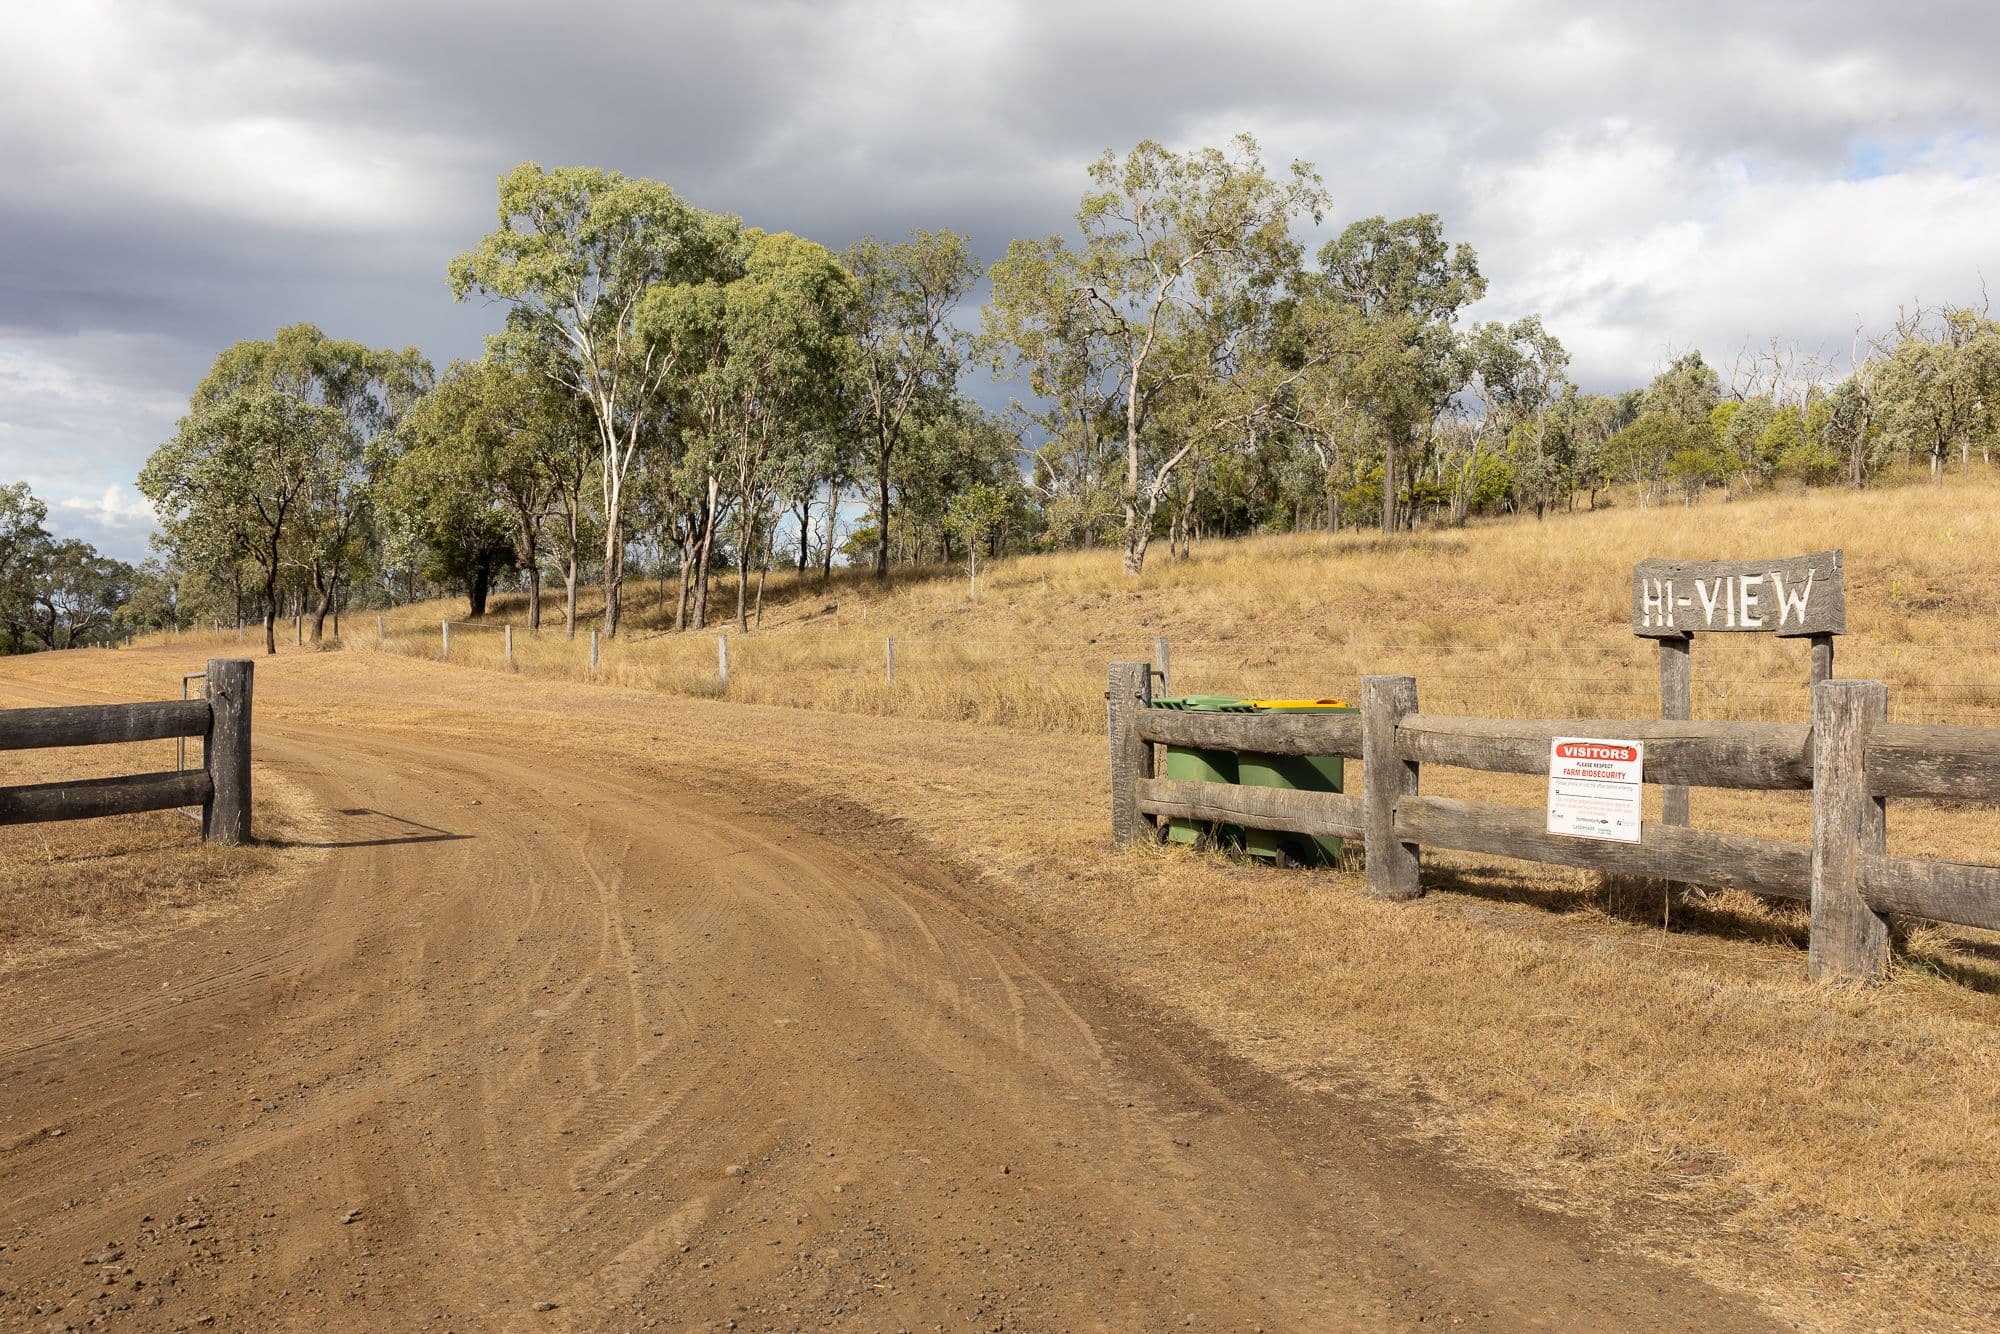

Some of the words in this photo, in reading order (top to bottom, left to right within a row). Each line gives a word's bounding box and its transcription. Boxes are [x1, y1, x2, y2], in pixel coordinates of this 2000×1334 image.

[1642, 568, 1816, 628] HI-VIEW
[1563, 747, 1629, 759] VISITORS
[1563, 768, 1581, 776] FARM
[1582, 769, 1626, 779] BIOSECURITY
